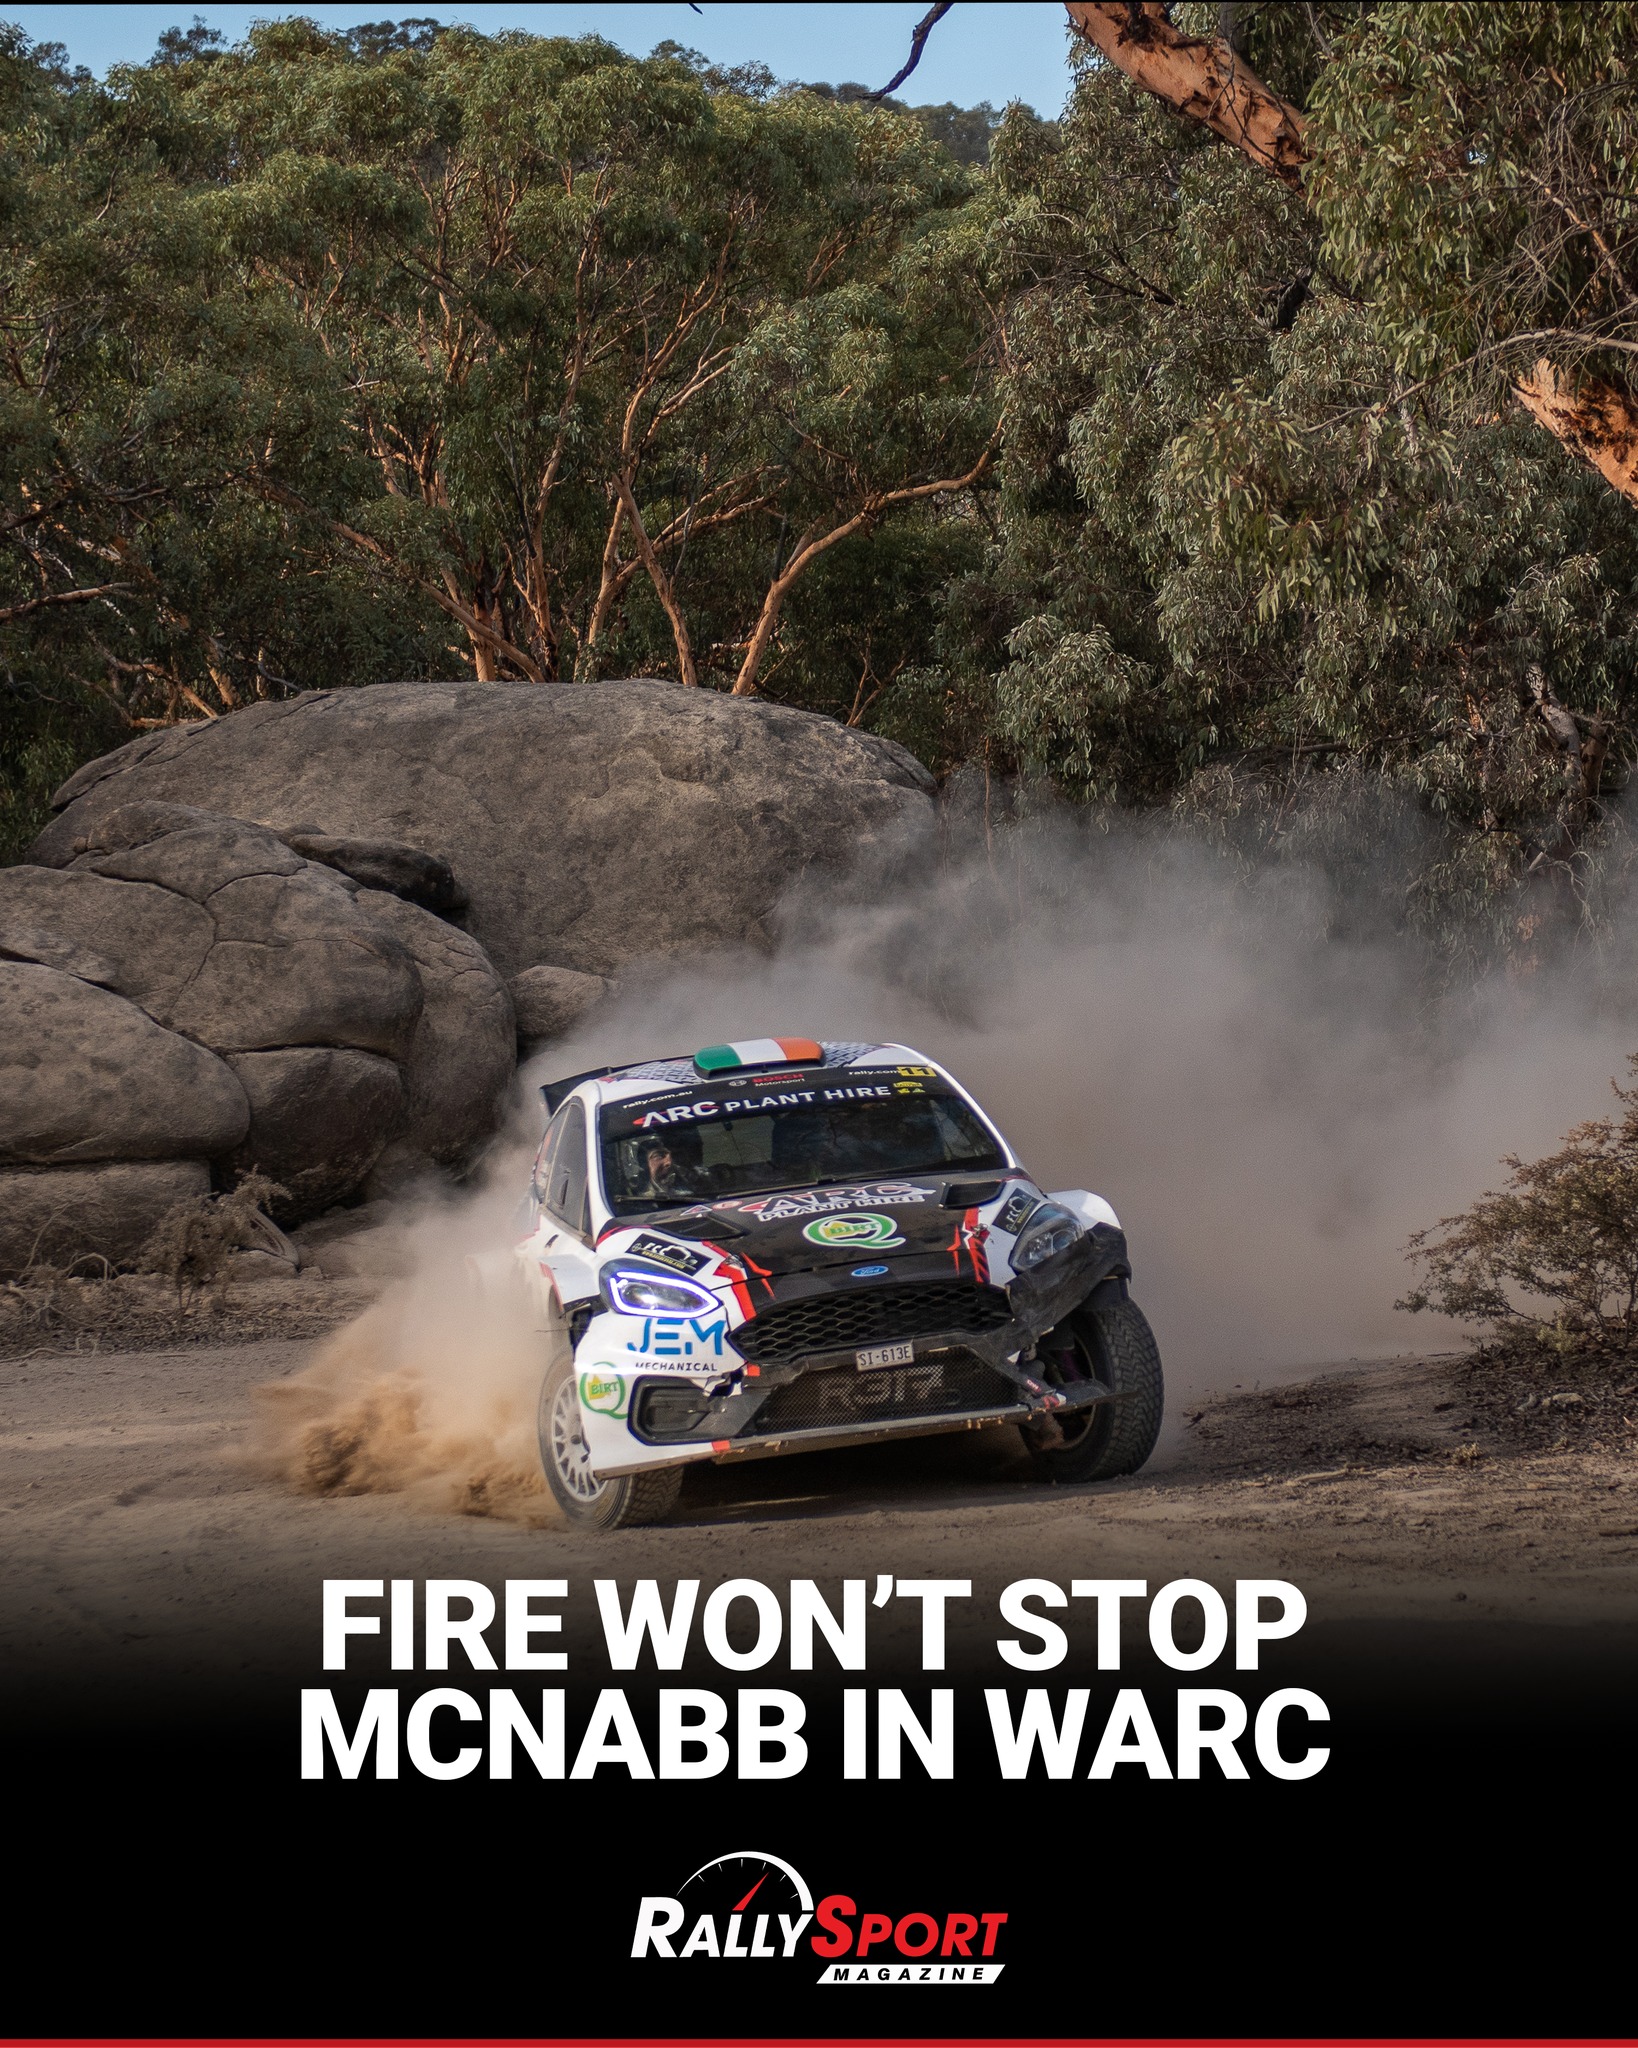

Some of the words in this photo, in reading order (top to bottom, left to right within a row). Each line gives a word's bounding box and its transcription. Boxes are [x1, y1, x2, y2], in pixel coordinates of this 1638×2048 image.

[752, 1073, 804, 1083] BOSCH
[901, 1067, 930, 1076] 11
[755, 1078, 805, 1087] Motorsport
[623, 1090, 693, 1109] rally.com.au
[641, 1101, 720, 1128] ARC
[725, 1091, 815, 1112] PLANT
[824, 1086, 892, 1100] HIRE
[754, 1182, 924, 1214] ARC
[758, 1199, 852, 1222] PLANT
[855, 1194, 925, 1207] HIRE
[626, 1318, 727, 1355] JEM
[635, 1362, 718, 1372] MECHANICAL
[591, 1381, 619, 1395] BIRT
